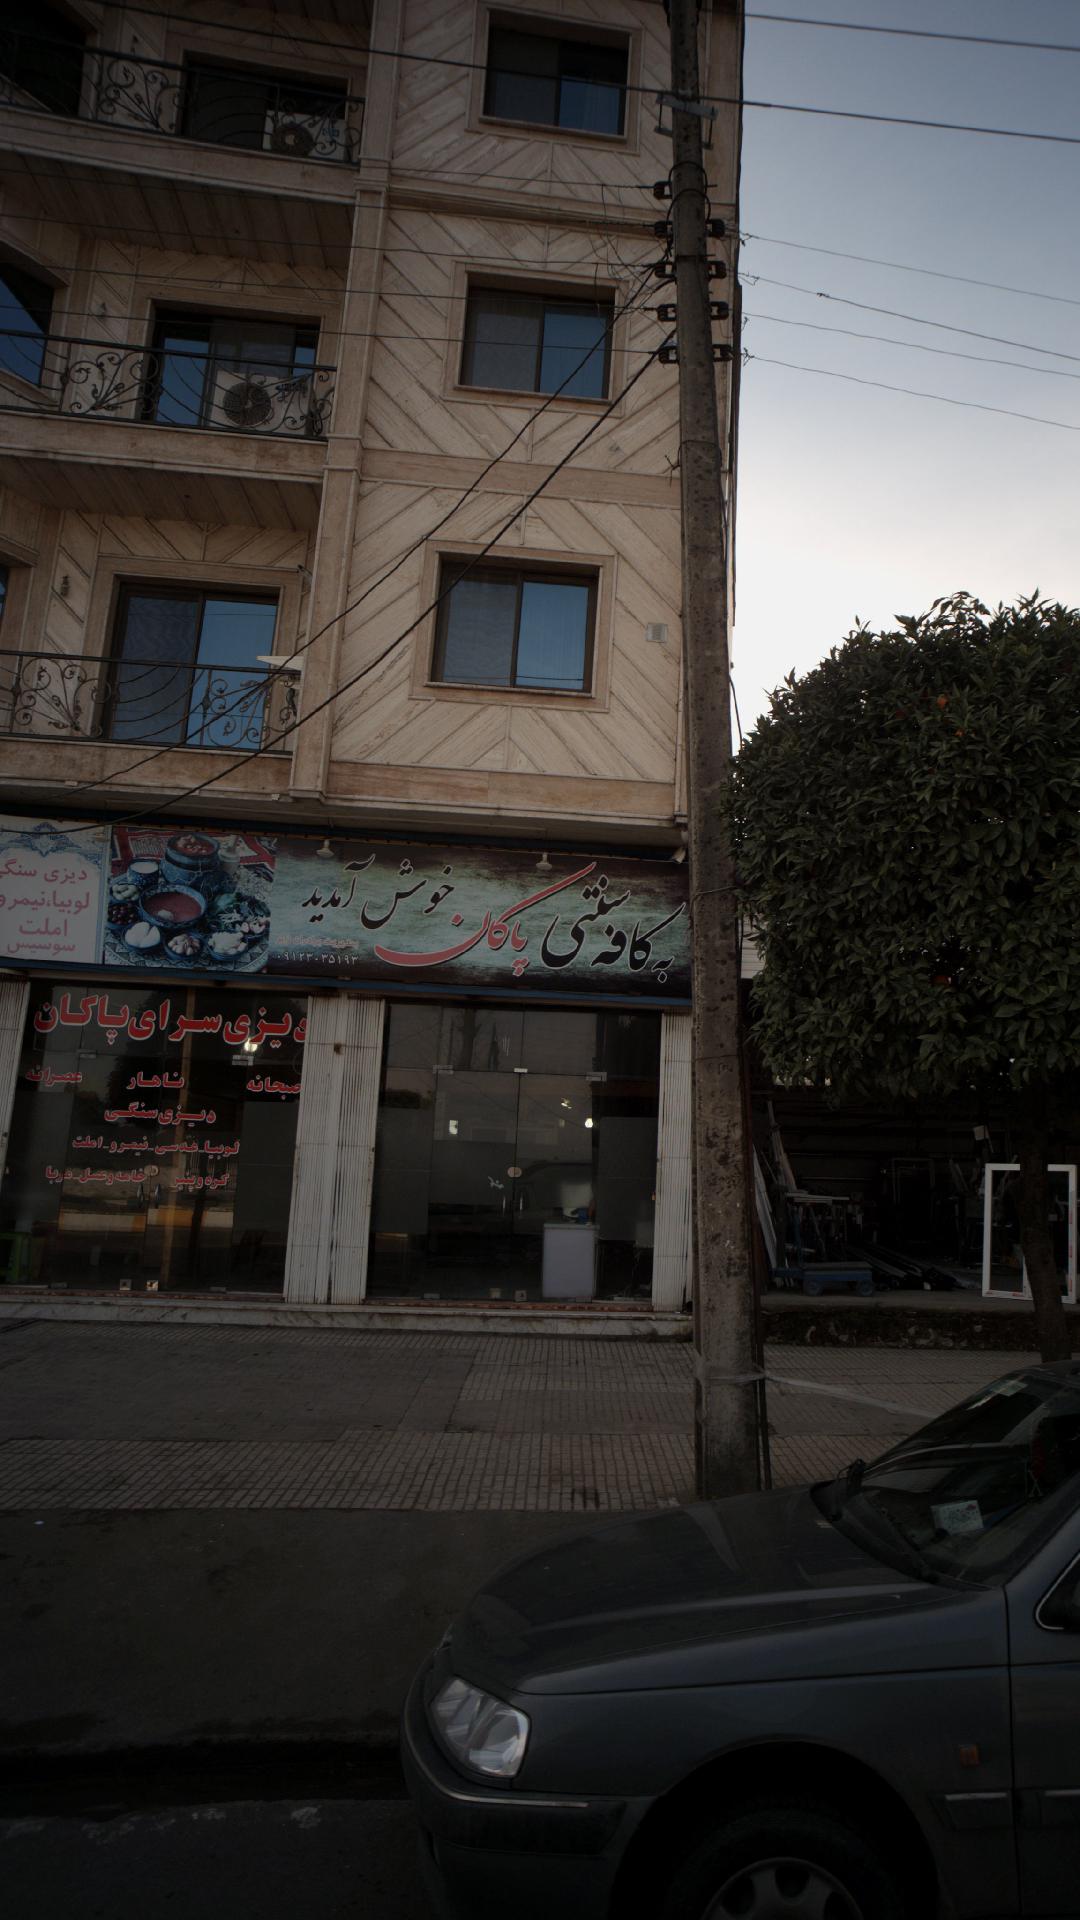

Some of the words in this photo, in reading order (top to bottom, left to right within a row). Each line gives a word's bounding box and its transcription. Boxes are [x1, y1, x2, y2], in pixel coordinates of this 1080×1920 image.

[0, 858, 37, 879] سنگ
[44, 868, 88, 885] دیزی
[302, 853, 377, 923] آمدید
[360, 857, 456, 930] خوش
[18, 917, 68, 937] املت
[373, 861, 598, 976] پاکان
[540, 873, 632, 970] سنتی
[7, 939, 77, 956] سوسیس
[590, 902, 687, 972] کافه
[650, 954, 675, 984] به
[33, 993, 129, 1045] پاکان
[128, 998, 222, 1042] سرای
[25, 1065, 82, 1087] عصرانه
[126, 1071, 185, 1090] ناهار
[246, 1074, 301, 1101] صبحانه
[103, 1101, 158, 1122] سنگی
[157, 1104, 217, 1128] دیزی
